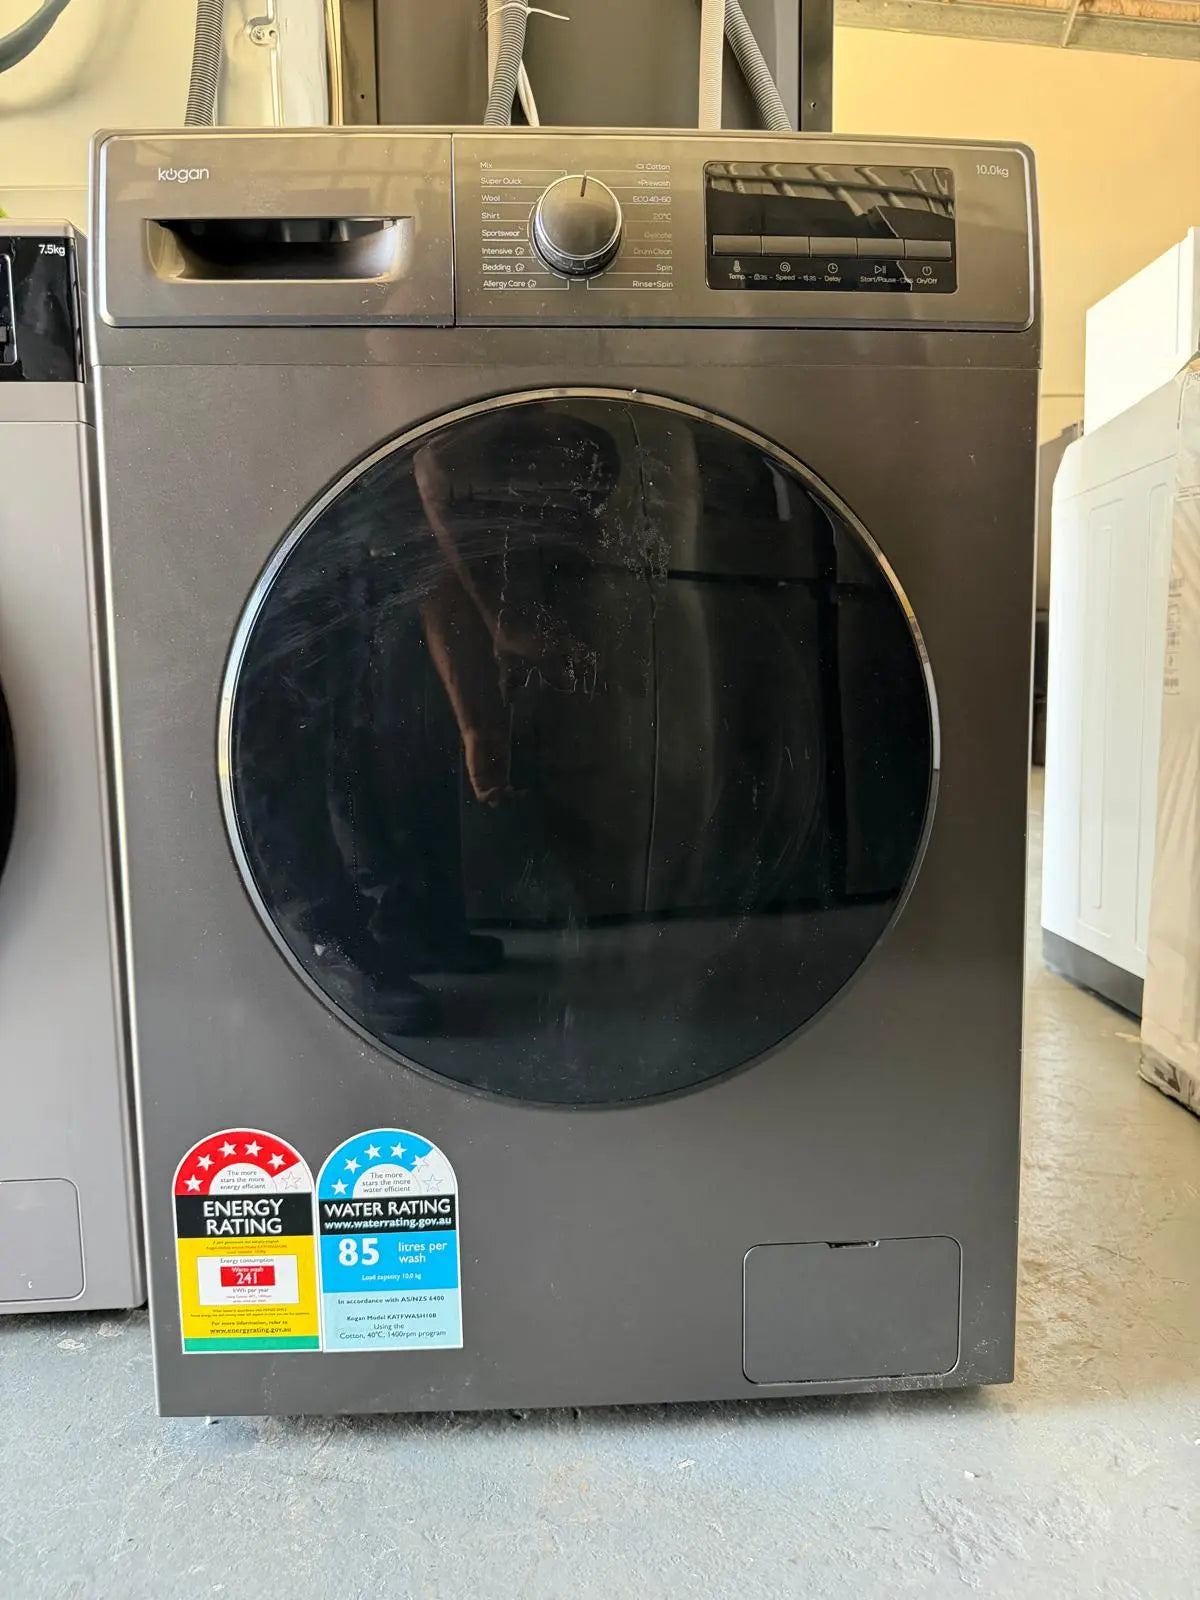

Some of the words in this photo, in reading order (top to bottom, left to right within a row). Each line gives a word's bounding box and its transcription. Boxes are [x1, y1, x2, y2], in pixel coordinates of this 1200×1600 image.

[158, 167, 209, 184] kogan
[975, 164, 1009, 178] 10.0kg
[480, 178, 502, 186] Super
[481, 194, 500, 202] Wool
[481, 230, 520, 238] Sportswear
[38, 244, 66, 256] 7.5kg
[482, 264, 511, 272] Bedding
[483, 280, 508, 289] Allergy
[508, 280, 526, 288] Care
[632, 280, 673, 288] Rinse+Spin
[203, 1199, 283, 1217] ENERGY
[324, 1203, 383, 1217] WATER
[388, 1199, 451, 1215] RATING
[206, 1218, 282, 1235] RATING
[324, 1217, 452, 1229] www.waterrating.gov.au
[339, 1238, 380, 1266] 85
[398, 1242, 425, 1252] litres
[429, 1242, 448, 1253] per
[399, 1253, 426, 1263] wash
[236, 1273, 258, 1285] 241
[387, 1331, 416, 1339] 1400rpm
[418, 1330, 446, 1338] program
